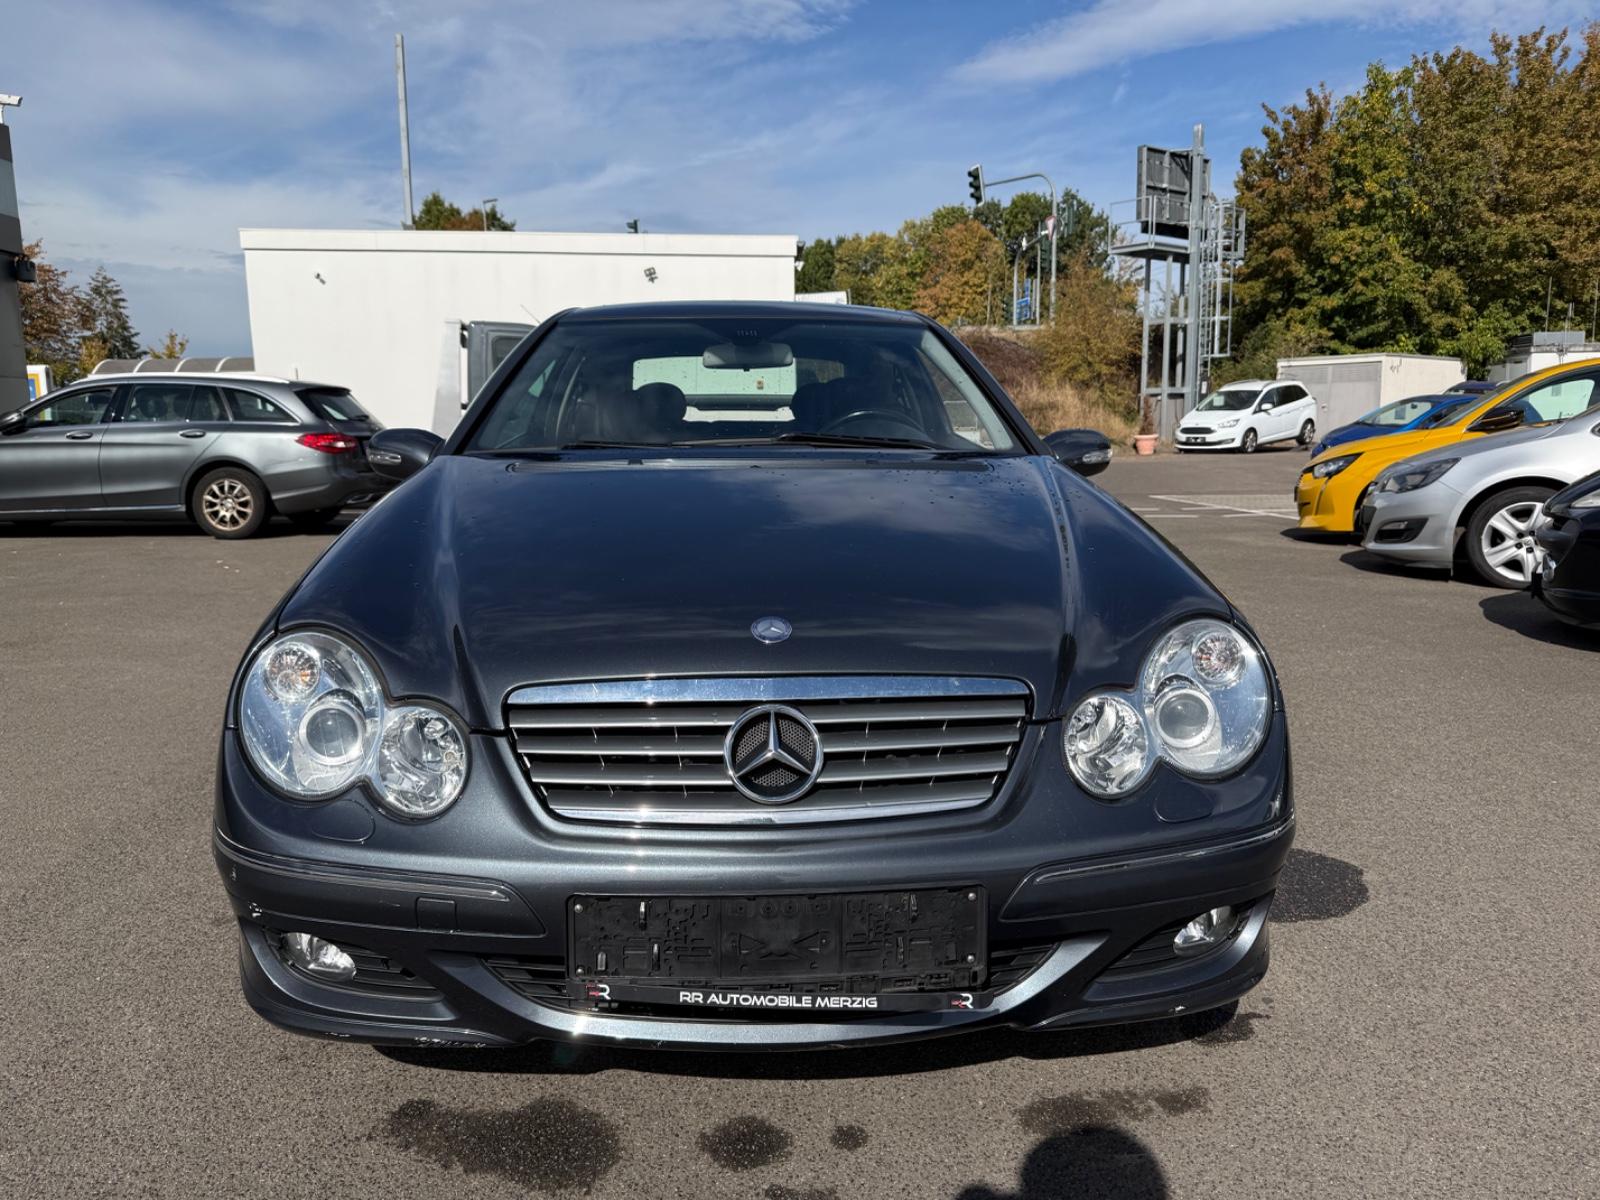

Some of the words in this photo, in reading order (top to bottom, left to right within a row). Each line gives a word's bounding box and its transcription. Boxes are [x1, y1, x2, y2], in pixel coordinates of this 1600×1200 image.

[679, 991, 704, 1004] RR
[707, 993, 812, 1008] AUTOMOBILE
[815, 996, 878, 1009] MERZIG
